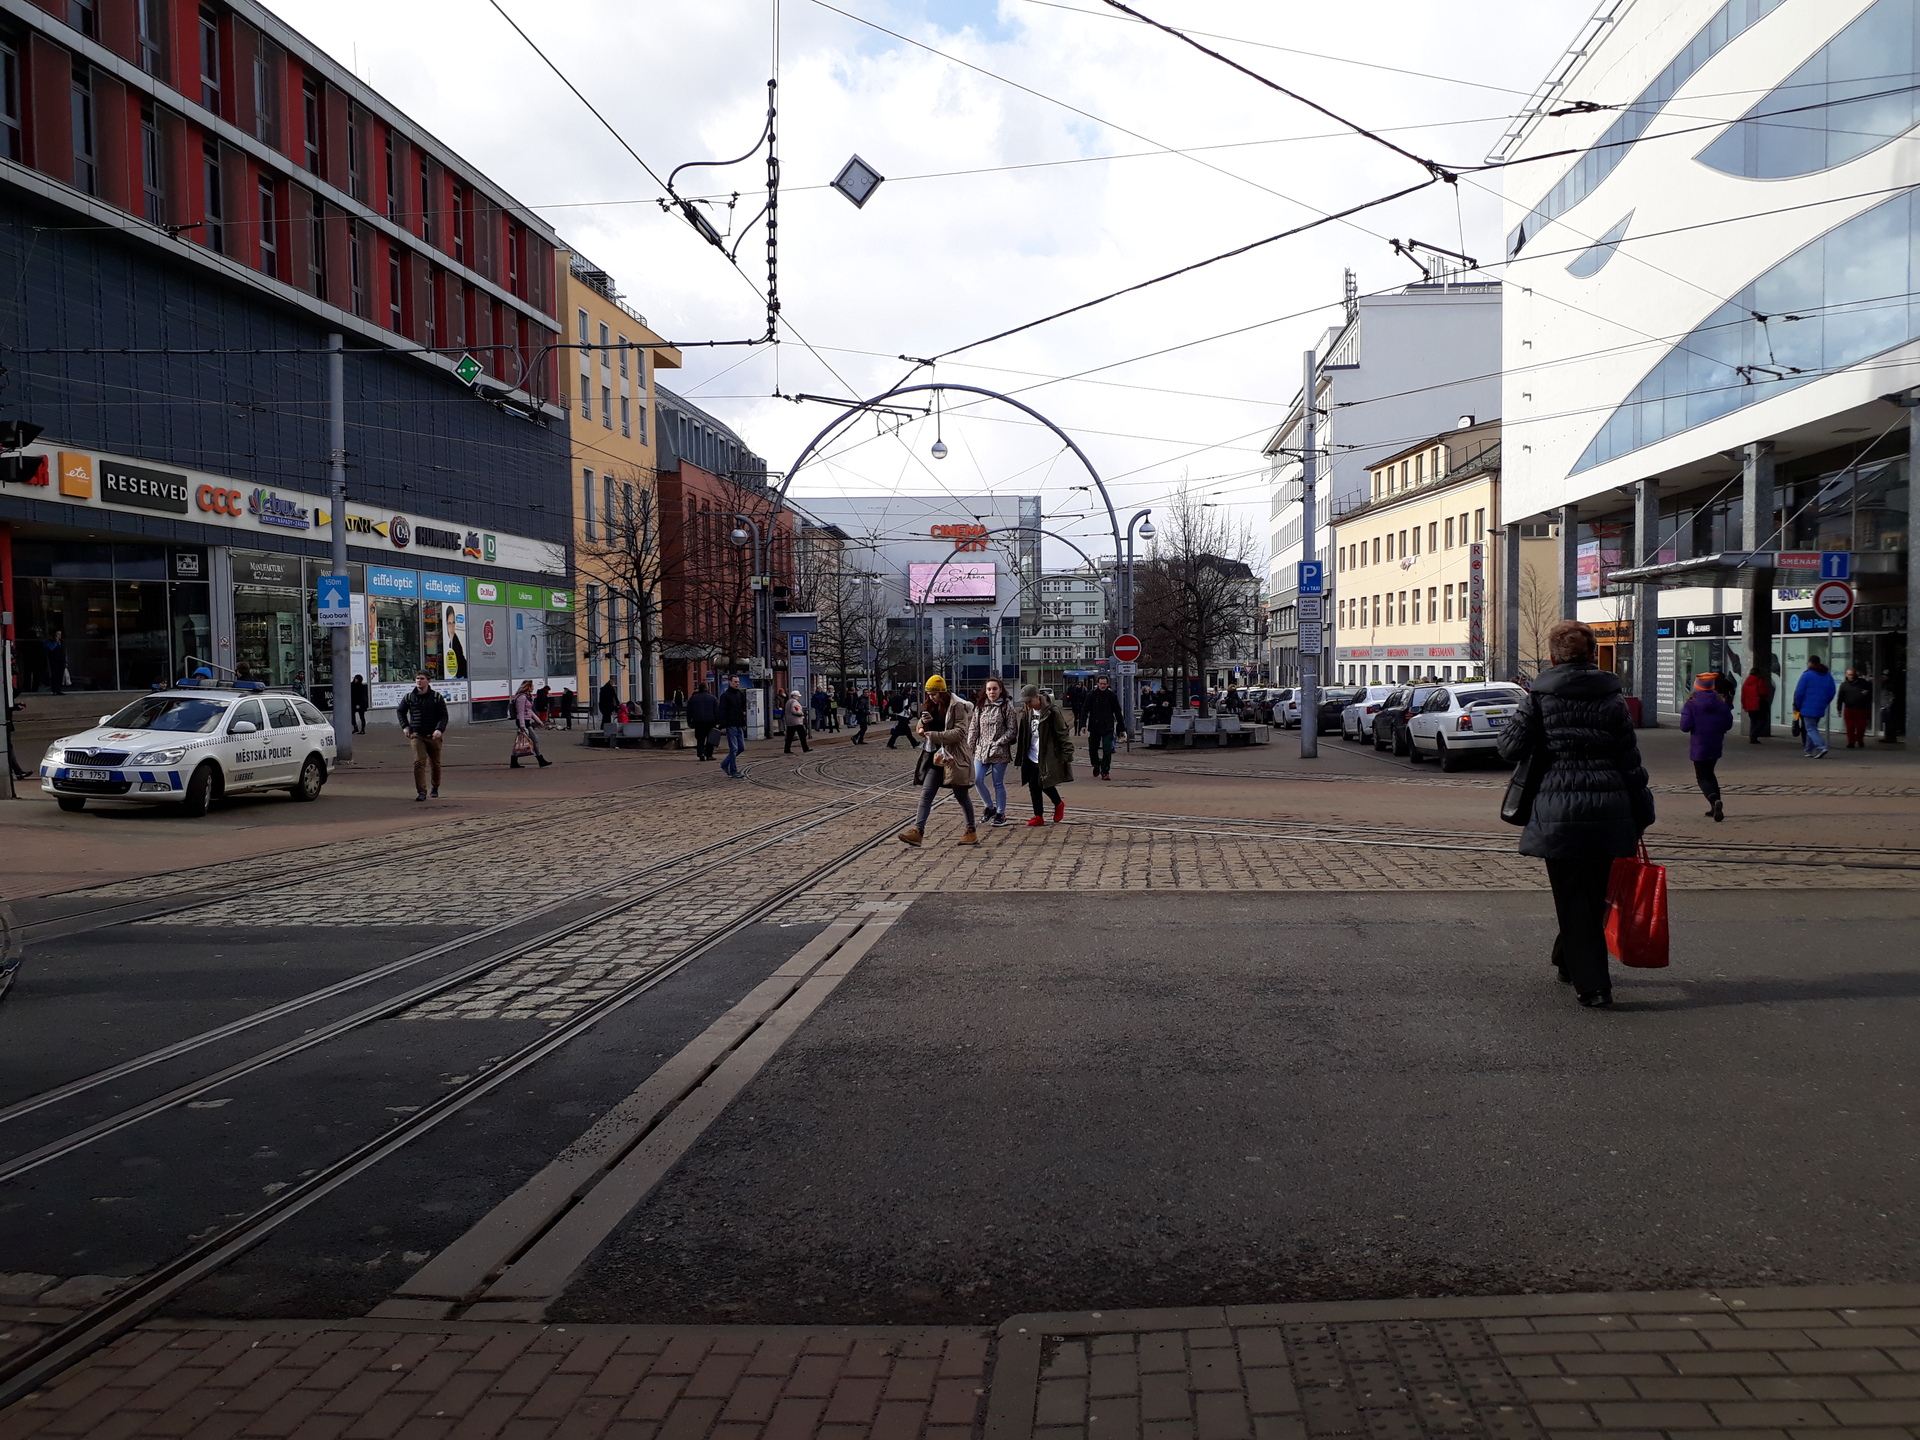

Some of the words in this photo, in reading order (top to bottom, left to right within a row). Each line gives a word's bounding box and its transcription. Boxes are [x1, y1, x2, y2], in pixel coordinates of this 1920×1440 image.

[65, 466, 91, 480] eta
[107, 473, 188, 501] RESERVED
[197, 484, 243, 517] CCC
[418, 527, 462, 550] HUMANIC
[931, 524, 989, 539] CINEMA
[955, 538, 989, 552] CITY
[1781, 557, 1821, 565] SMĚNÁR
[373, 573, 393, 587] eiffel
[393, 577, 413, 591] optic
[1303, 565, 1318, 585] P
[425, 579, 443, 592] eiffel
[443, 582, 461, 595] optic
[319, 612, 334, 621] Equa
[1351, 649, 1370, 658] ROSSMANN
[1387, 648, 1409, 657] ROSSMANN
[1428, 647, 1455, 657] ROSSMANN
[325, 735, 334, 747] 156
[235, 746, 267, 763] MĚSTSKÁ
[268, 746, 292, 760] POLICIE
[71, 770, 84, 779] 3L6
[89, 771, 107, 780] 1753
[234, 772, 254, 781] LIBEREC
